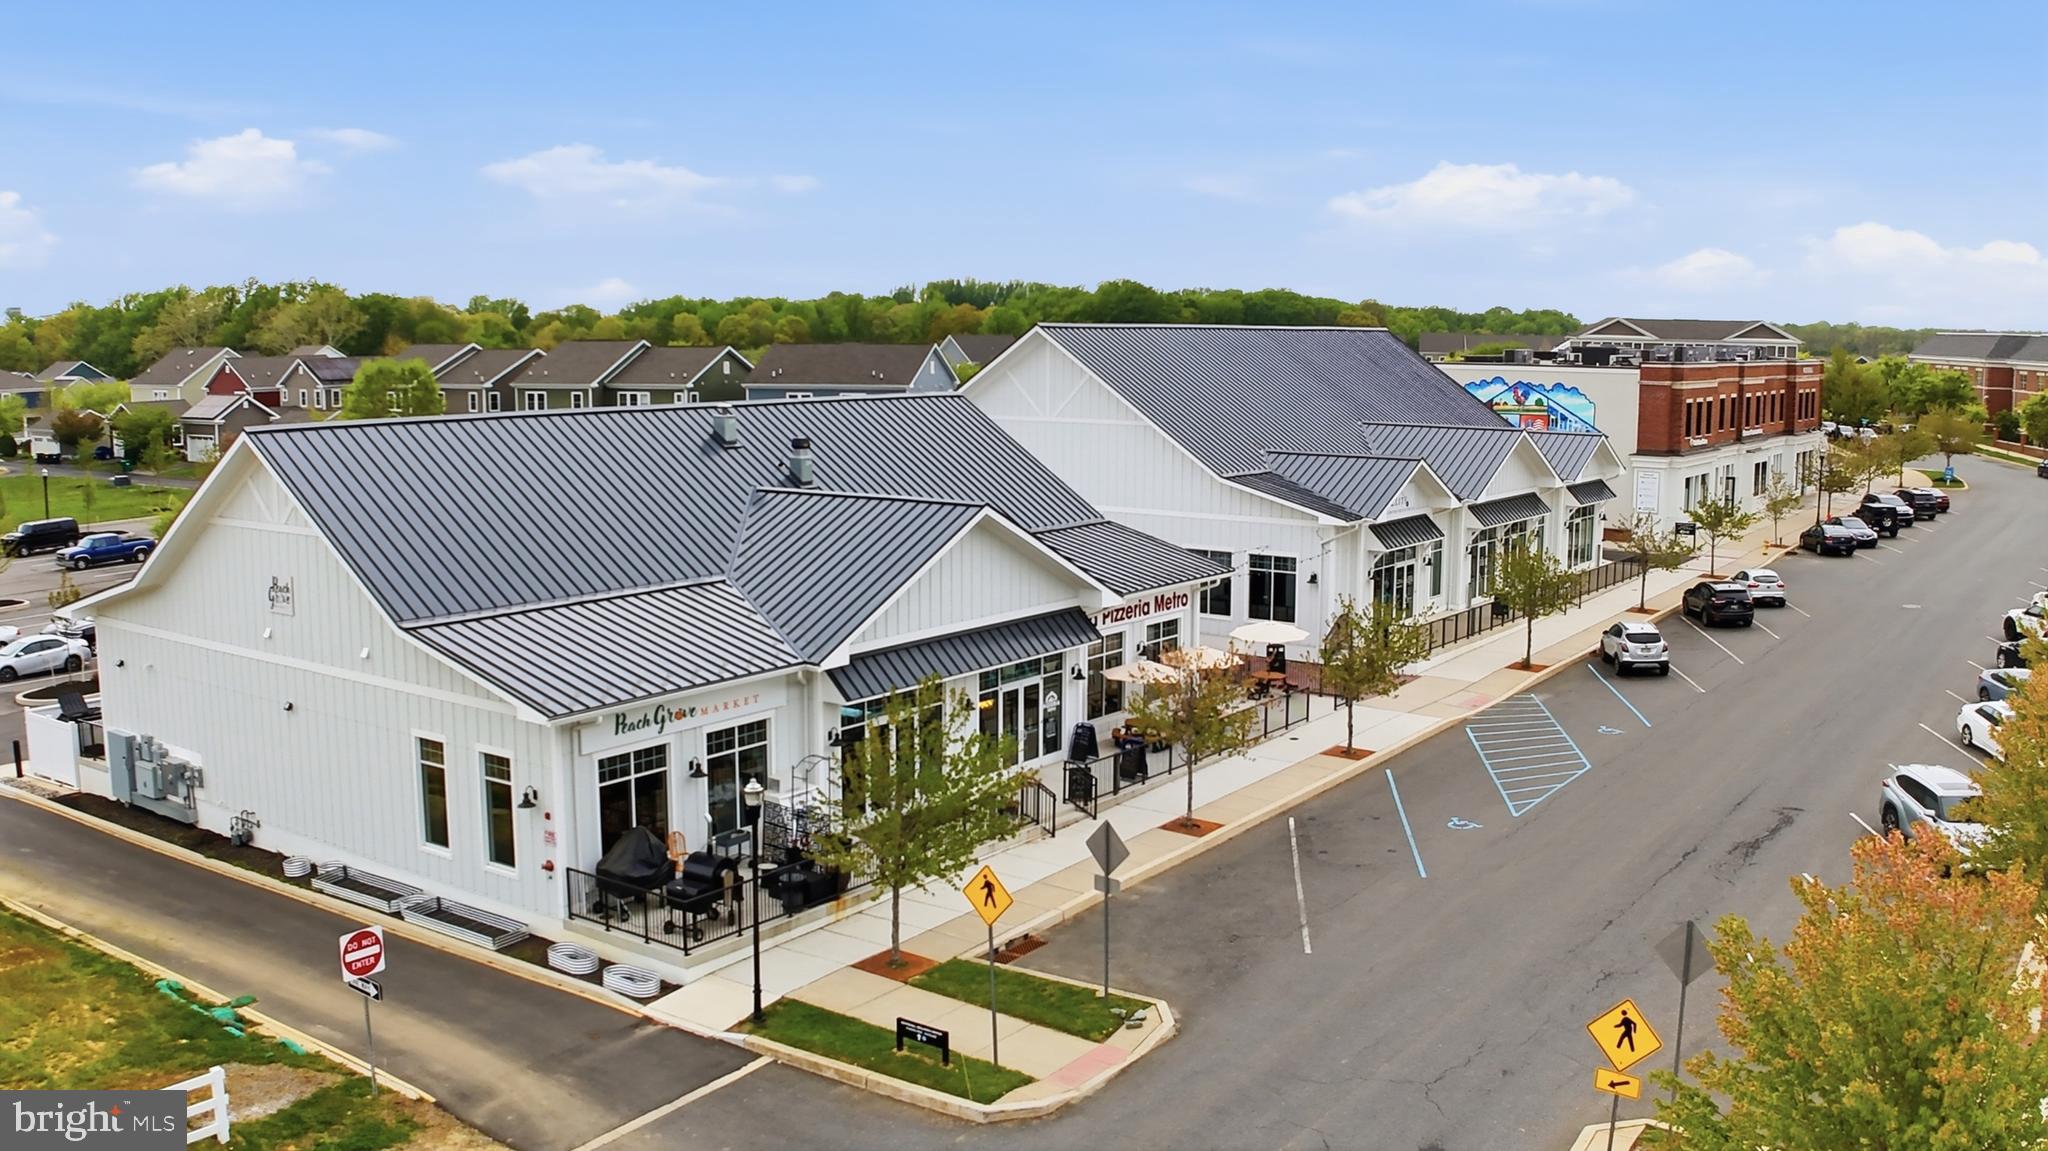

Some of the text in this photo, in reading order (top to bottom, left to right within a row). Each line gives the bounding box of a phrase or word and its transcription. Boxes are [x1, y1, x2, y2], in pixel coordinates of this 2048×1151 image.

[1103, 600, 1150, 625] Pizzeria
[1154, 592, 1188, 613] Metro
[615, 694, 760, 735] Peach Grove MARKET
[347, 936, 376, 951] DO NOT
[351, 956, 375, 970] ENTER
